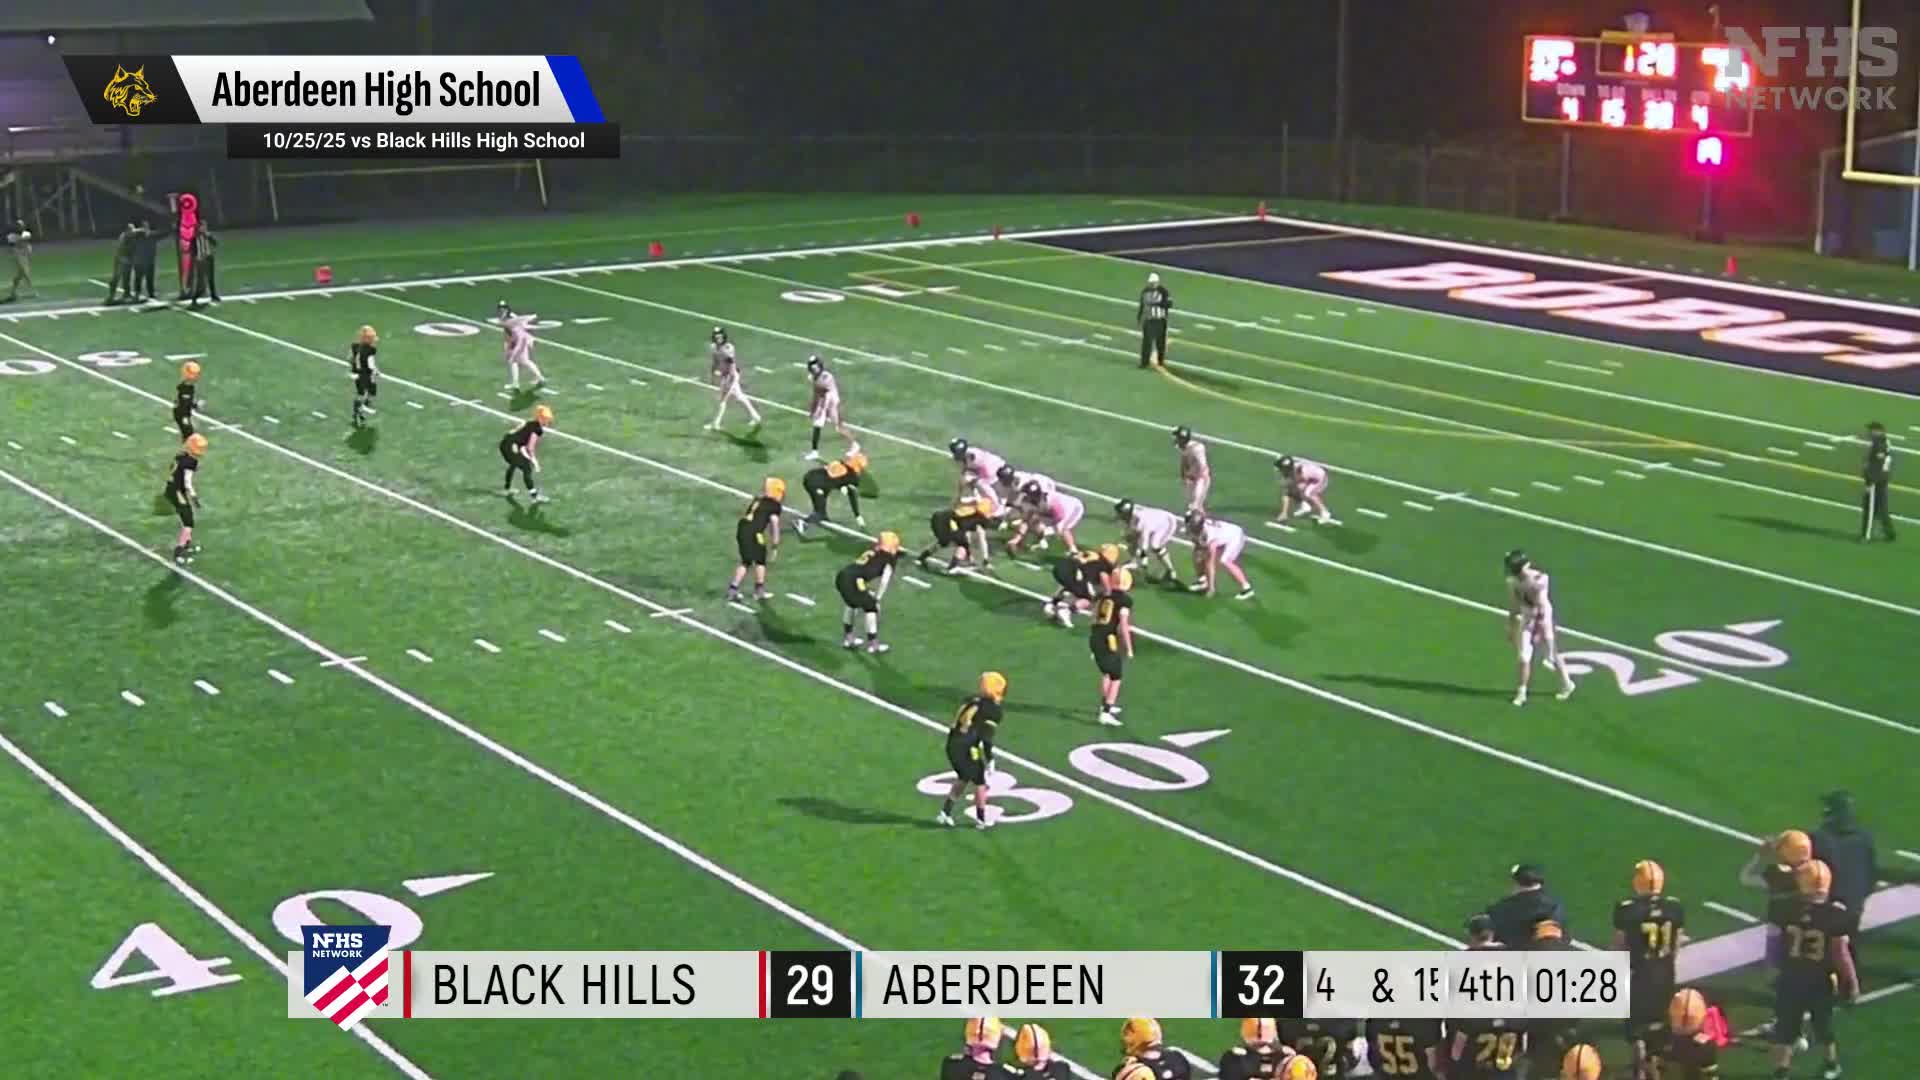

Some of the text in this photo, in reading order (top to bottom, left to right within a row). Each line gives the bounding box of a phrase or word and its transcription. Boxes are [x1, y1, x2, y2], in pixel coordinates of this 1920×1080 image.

[1556, 629, 1790, 696] 20
[918, 741, 1210, 828] 30
[90, 889, 424, 997] 40
[1377, 1033, 1418, 1074] 55
